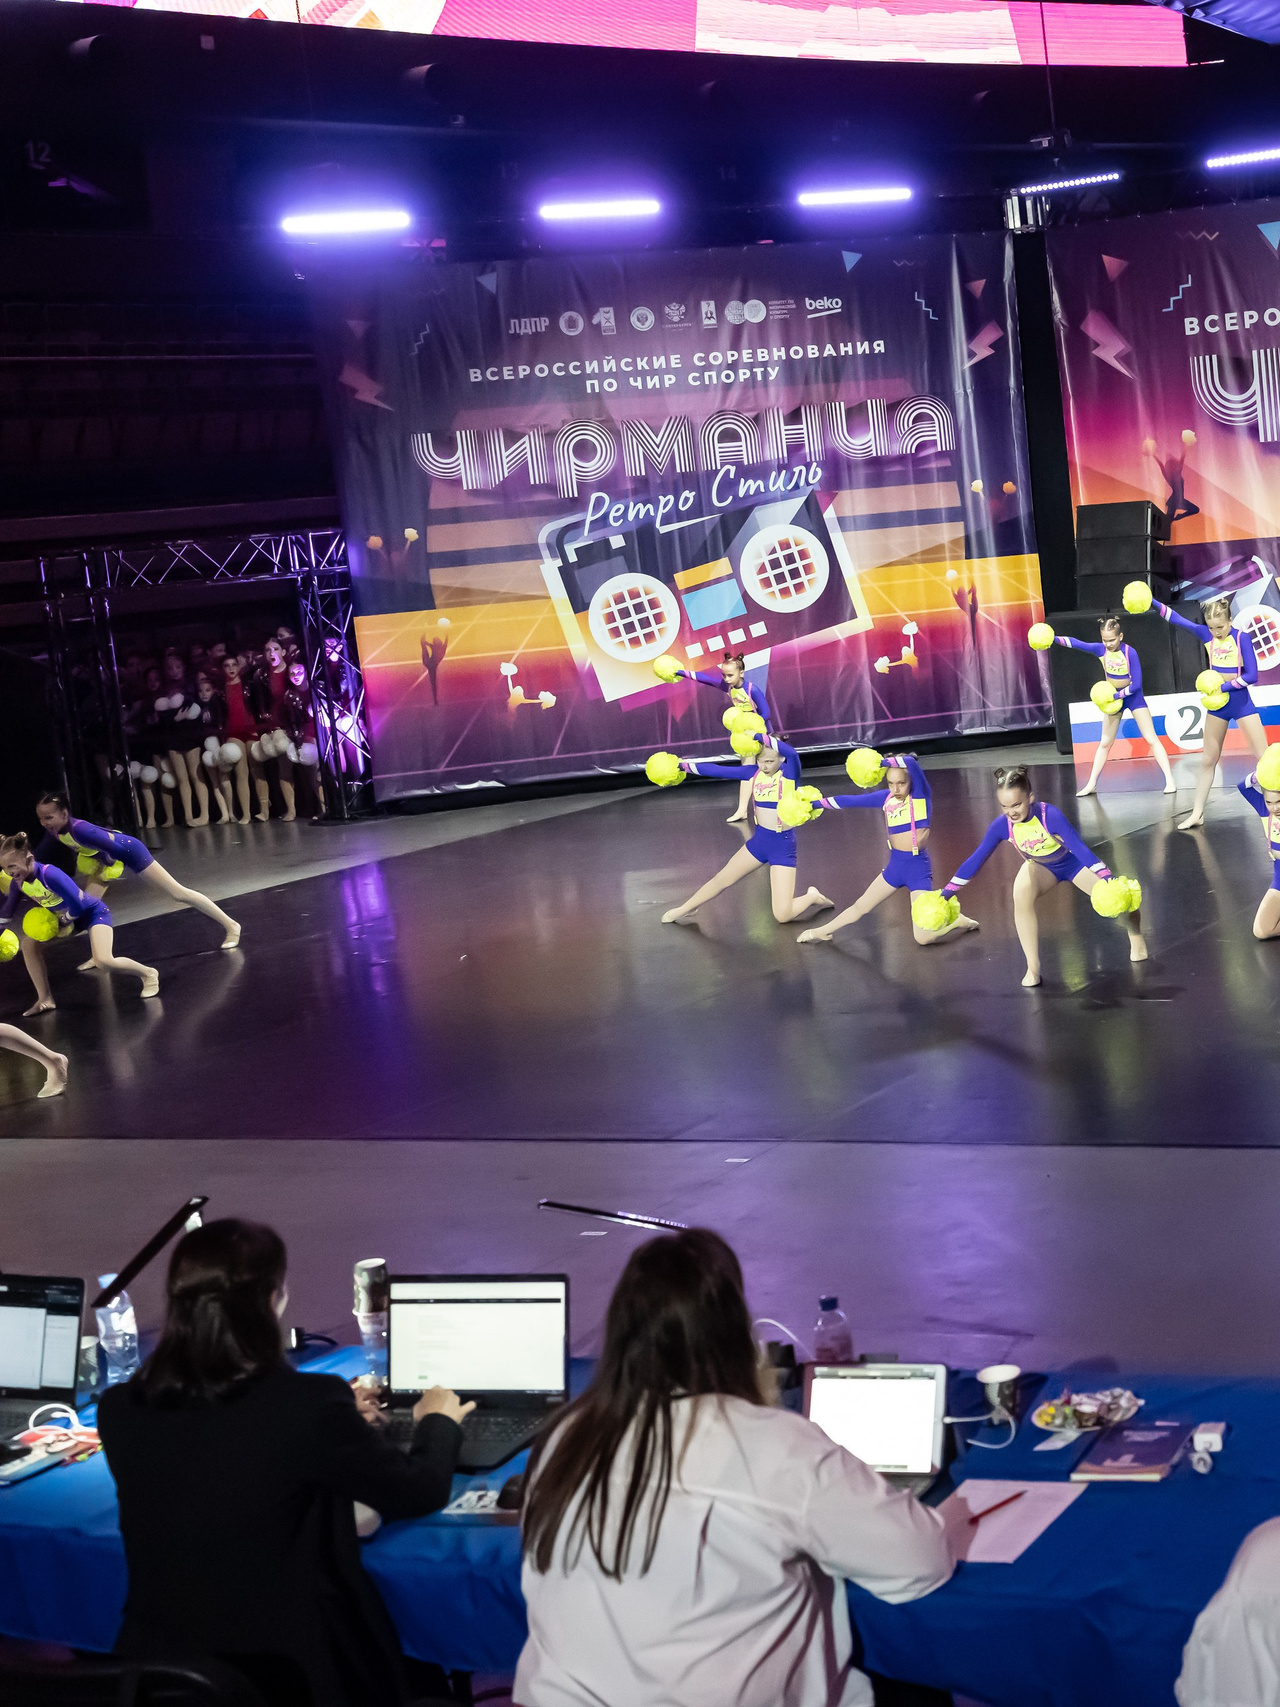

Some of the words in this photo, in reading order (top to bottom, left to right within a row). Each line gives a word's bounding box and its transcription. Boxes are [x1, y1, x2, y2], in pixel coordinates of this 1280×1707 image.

[24, 140, 51, 162] 12
[805, 297, 842, 310] beko
[508, 317, 549, 335] ЛДПР
[469, 354, 682, 383] ВСЕРОССИЙСКИЕ
[693, 340, 885, 366] СОРЕВНОВАНИЯ
[586, 379, 618, 393] ПО
[629, 374, 676, 390] ЧИР
[688, 366, 780, 386] СПОРТУ
[583, 490, 695, 536] Ретро
[711, 462, 823, 507] Стиль
[1178, 705, 1204, 741] 2
